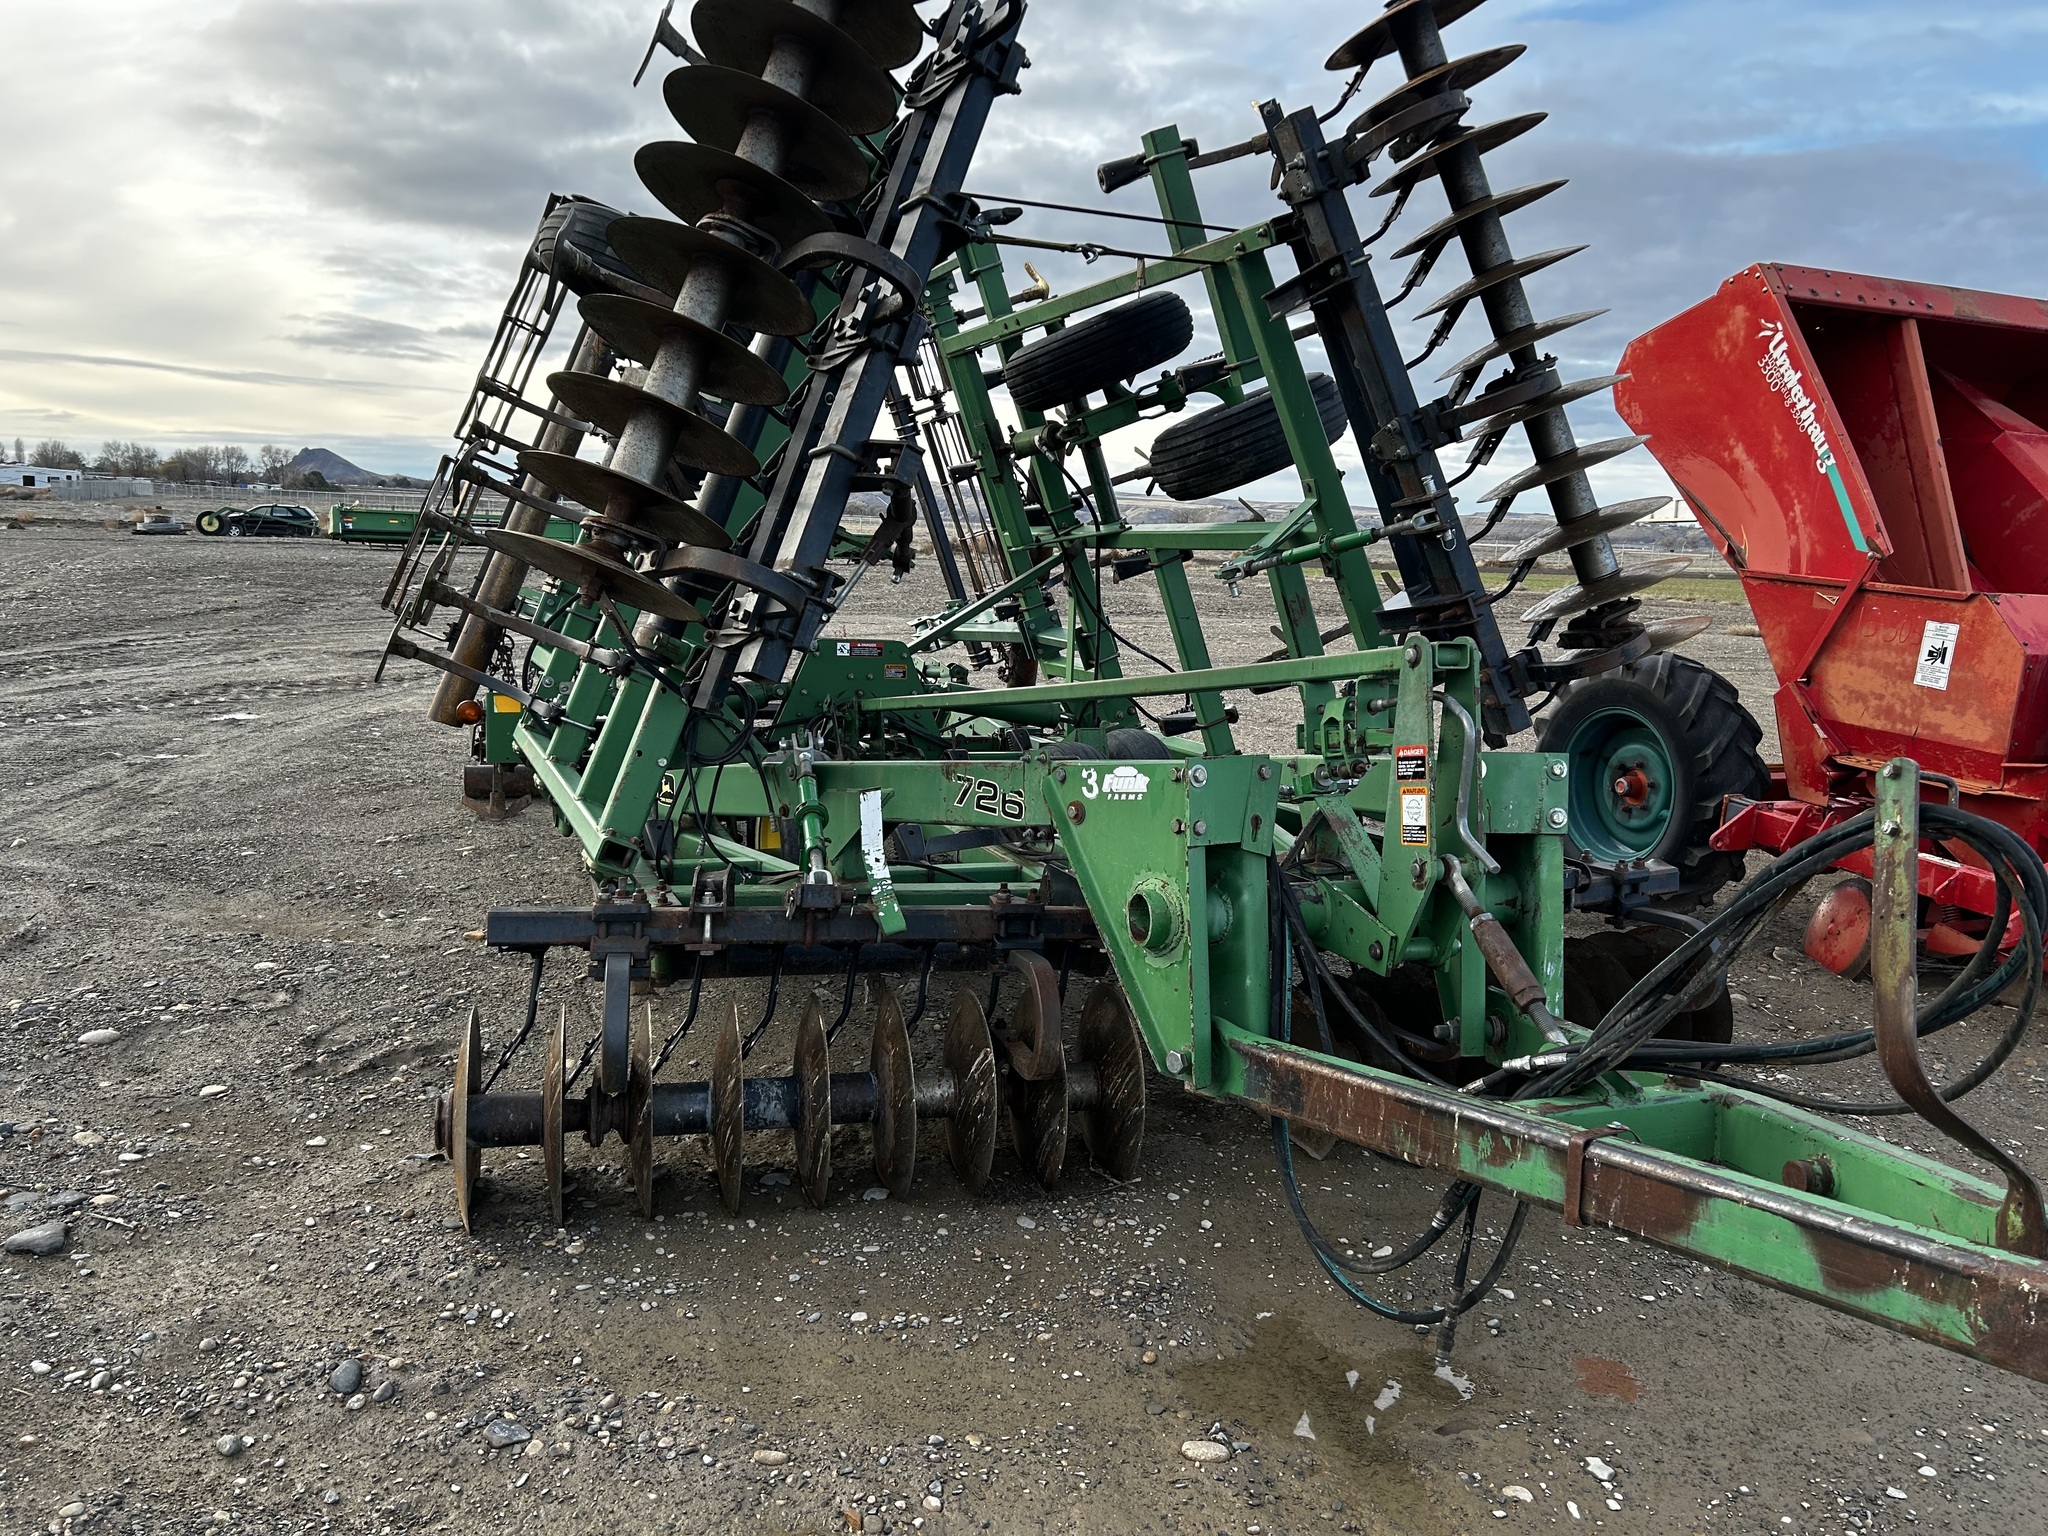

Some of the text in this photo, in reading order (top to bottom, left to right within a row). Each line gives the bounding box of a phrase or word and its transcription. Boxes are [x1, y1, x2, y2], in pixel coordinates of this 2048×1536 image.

[1757, 353, 1781, 392] 3300
[1790, 406, 1809, 432] 3300
[951, 773, 1025, 821] 726
[1081, 767, 1099, 800] 3
